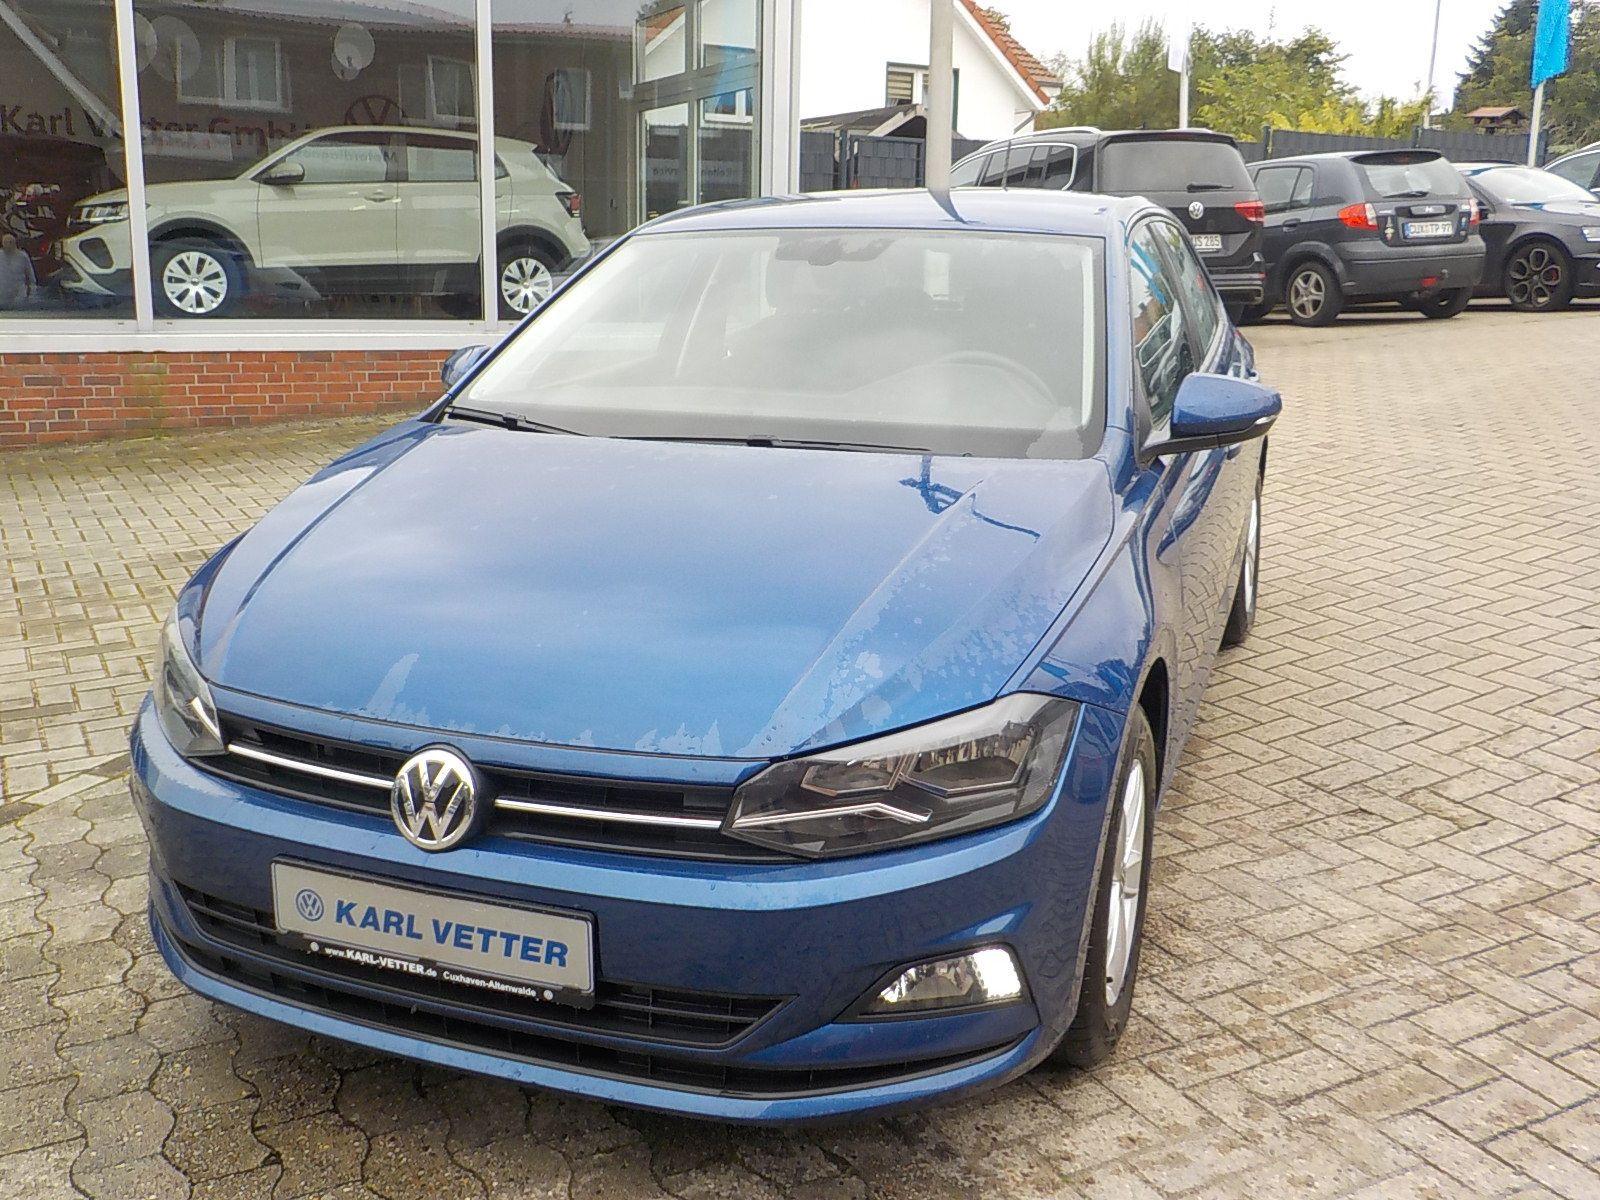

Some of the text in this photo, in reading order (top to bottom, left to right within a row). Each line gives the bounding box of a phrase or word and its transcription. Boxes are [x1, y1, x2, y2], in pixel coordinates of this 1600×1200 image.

[0, 105, 75, 136] Karl
[80, 105, 199, 140] Vter
[335, 899, 569, 968] KARL VETTER
[324, 947, 537, 997] www.KARL-VETTER.de Cuxhaven-Altenwalde
